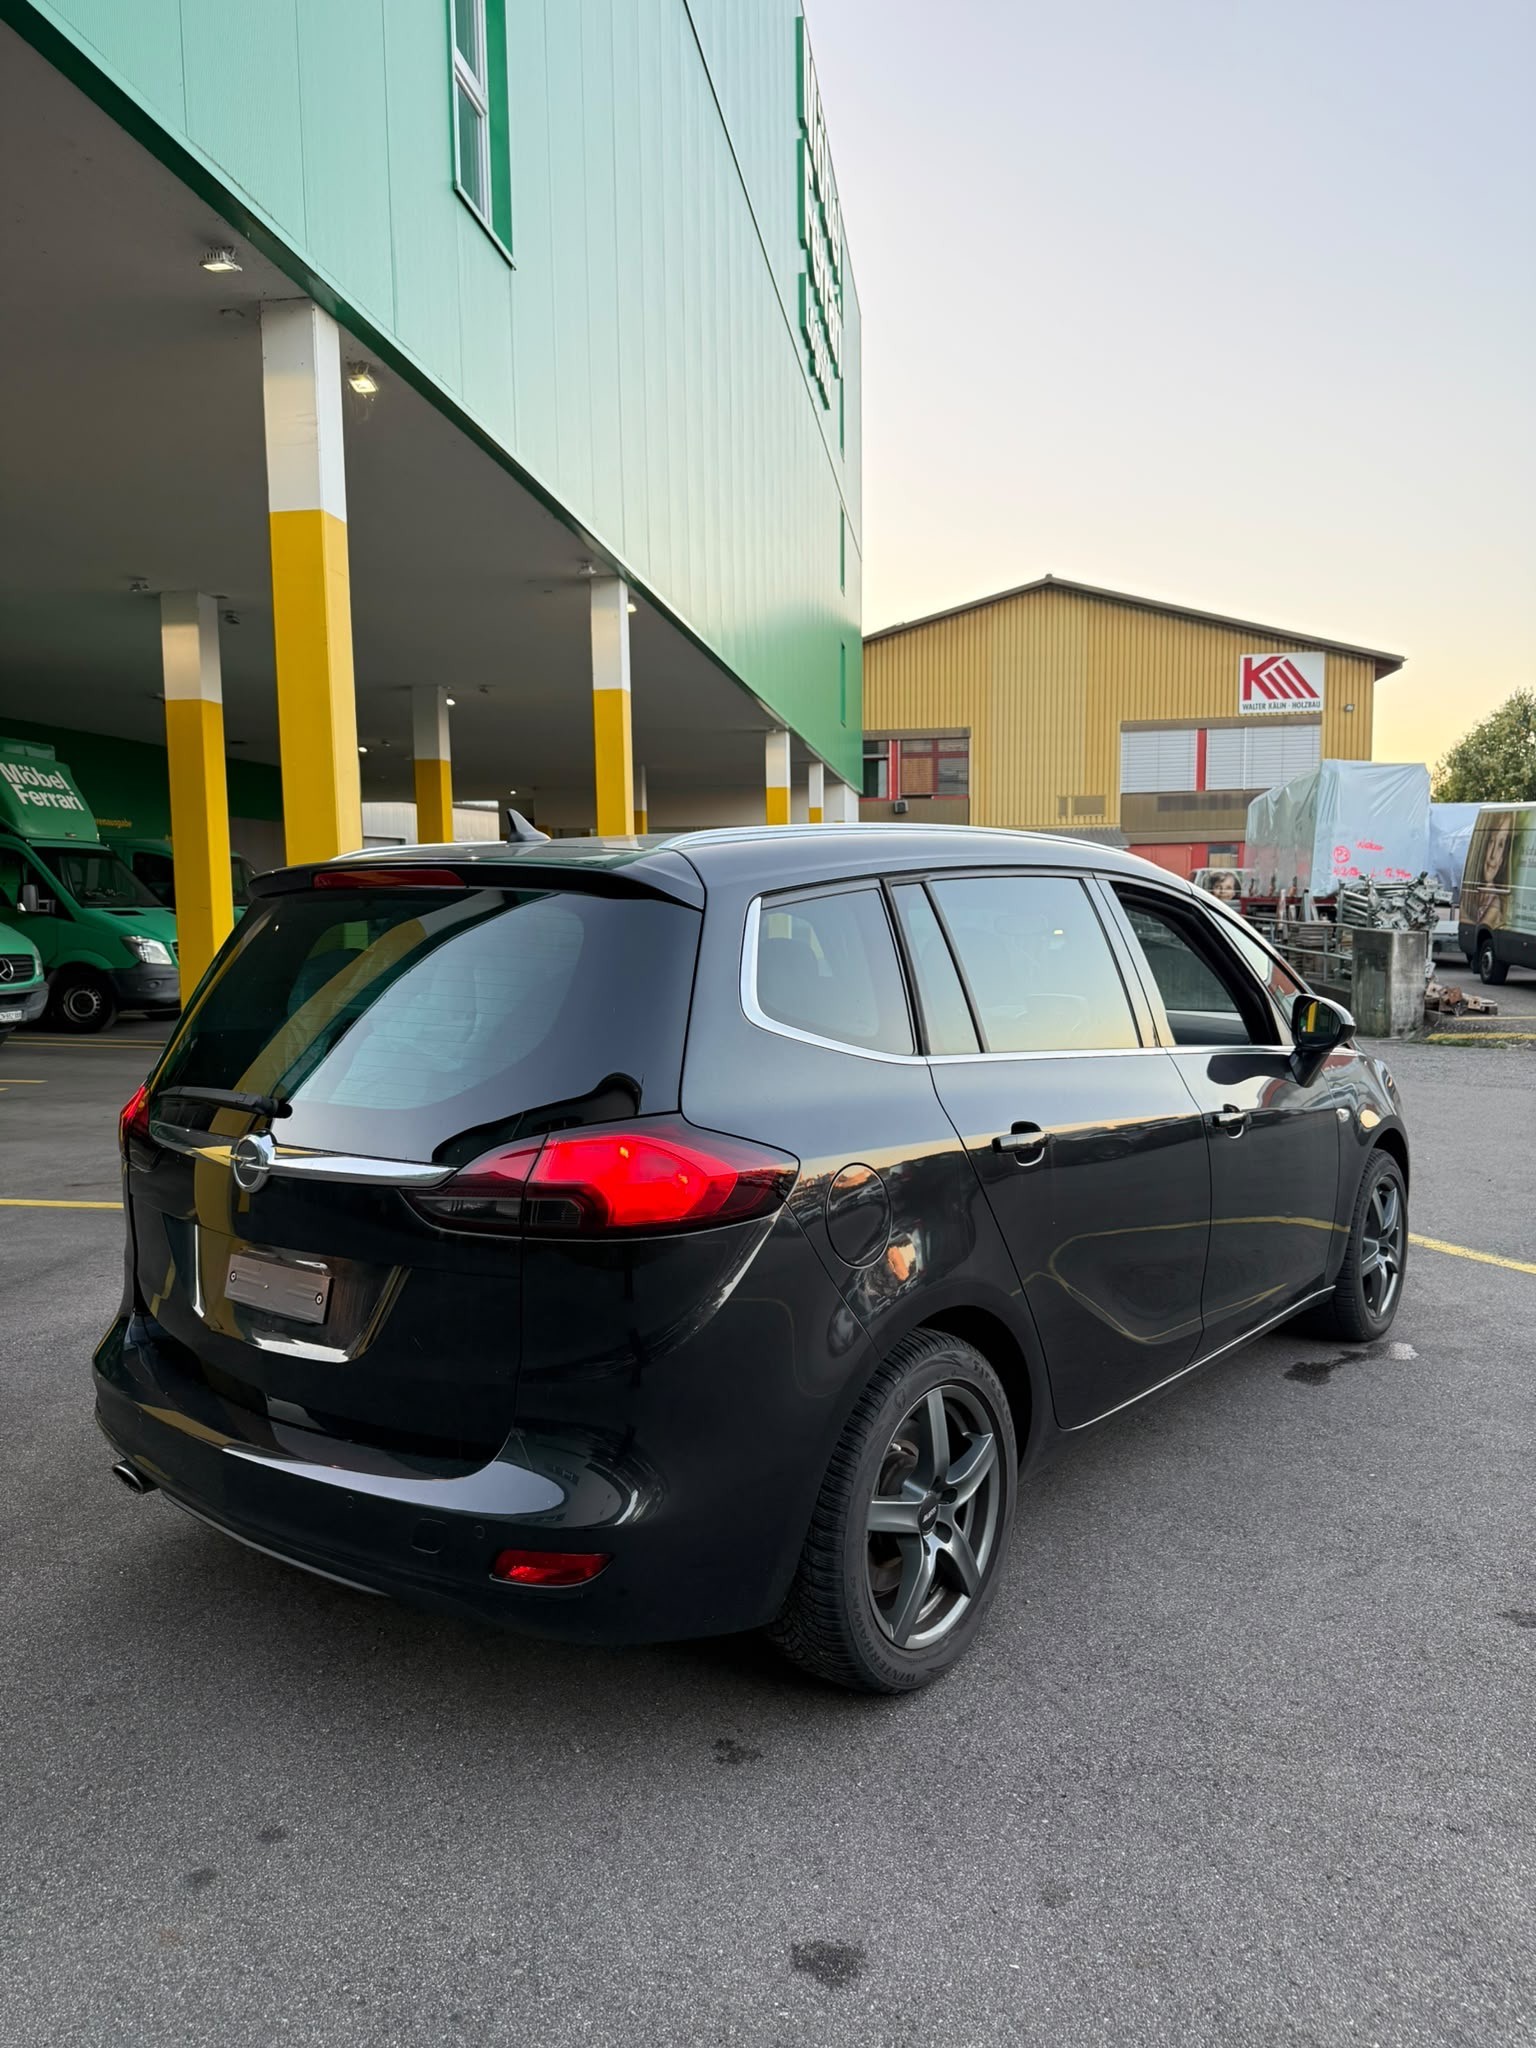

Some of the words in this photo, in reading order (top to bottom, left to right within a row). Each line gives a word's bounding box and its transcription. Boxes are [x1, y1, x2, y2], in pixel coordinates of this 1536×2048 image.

[798, 15, 842, 285] Möbel
[799, 138, 843, 379] Ferrari
[1242, 703, 1267, 711] WALTER
[1292, 700, 1321, 709] HOLZBAU
[0, 762, 71, 790] Möbel
[11, 783, 85, 811] Ferrari
